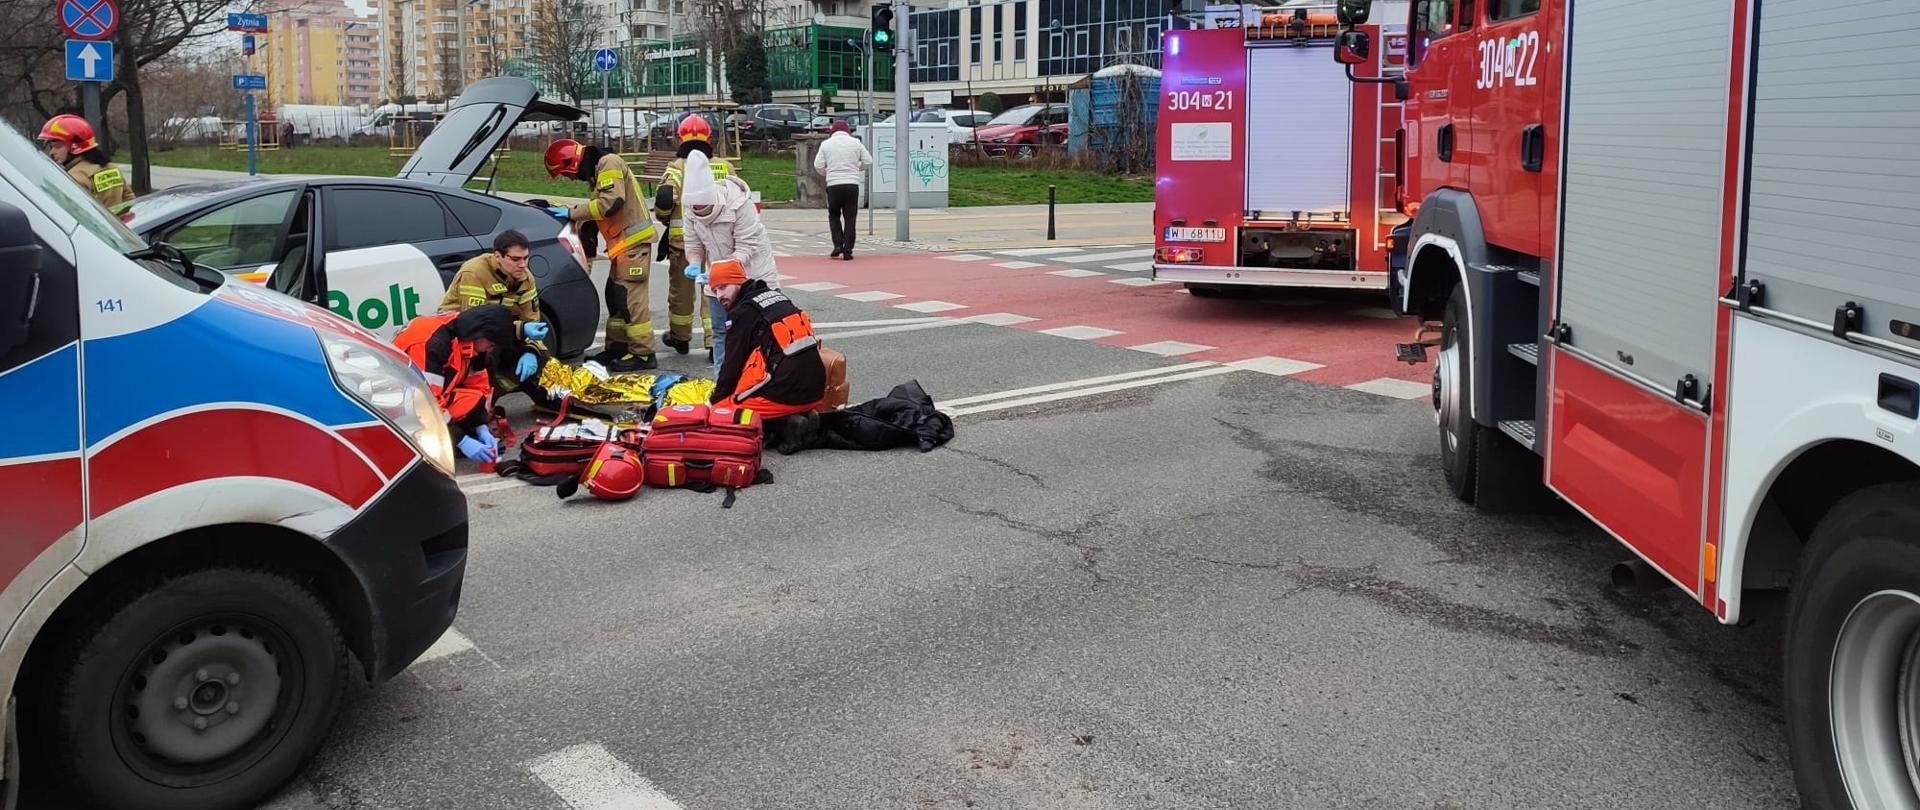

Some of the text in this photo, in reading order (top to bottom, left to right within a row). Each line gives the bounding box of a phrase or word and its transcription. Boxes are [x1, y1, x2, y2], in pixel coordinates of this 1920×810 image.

[237, 16, 260, 28] Żytnia
[1191, 229, 1223, 239] 6811U
[96, 299, 122, 312] 141
[327, 283, 420, 330] Bolt
